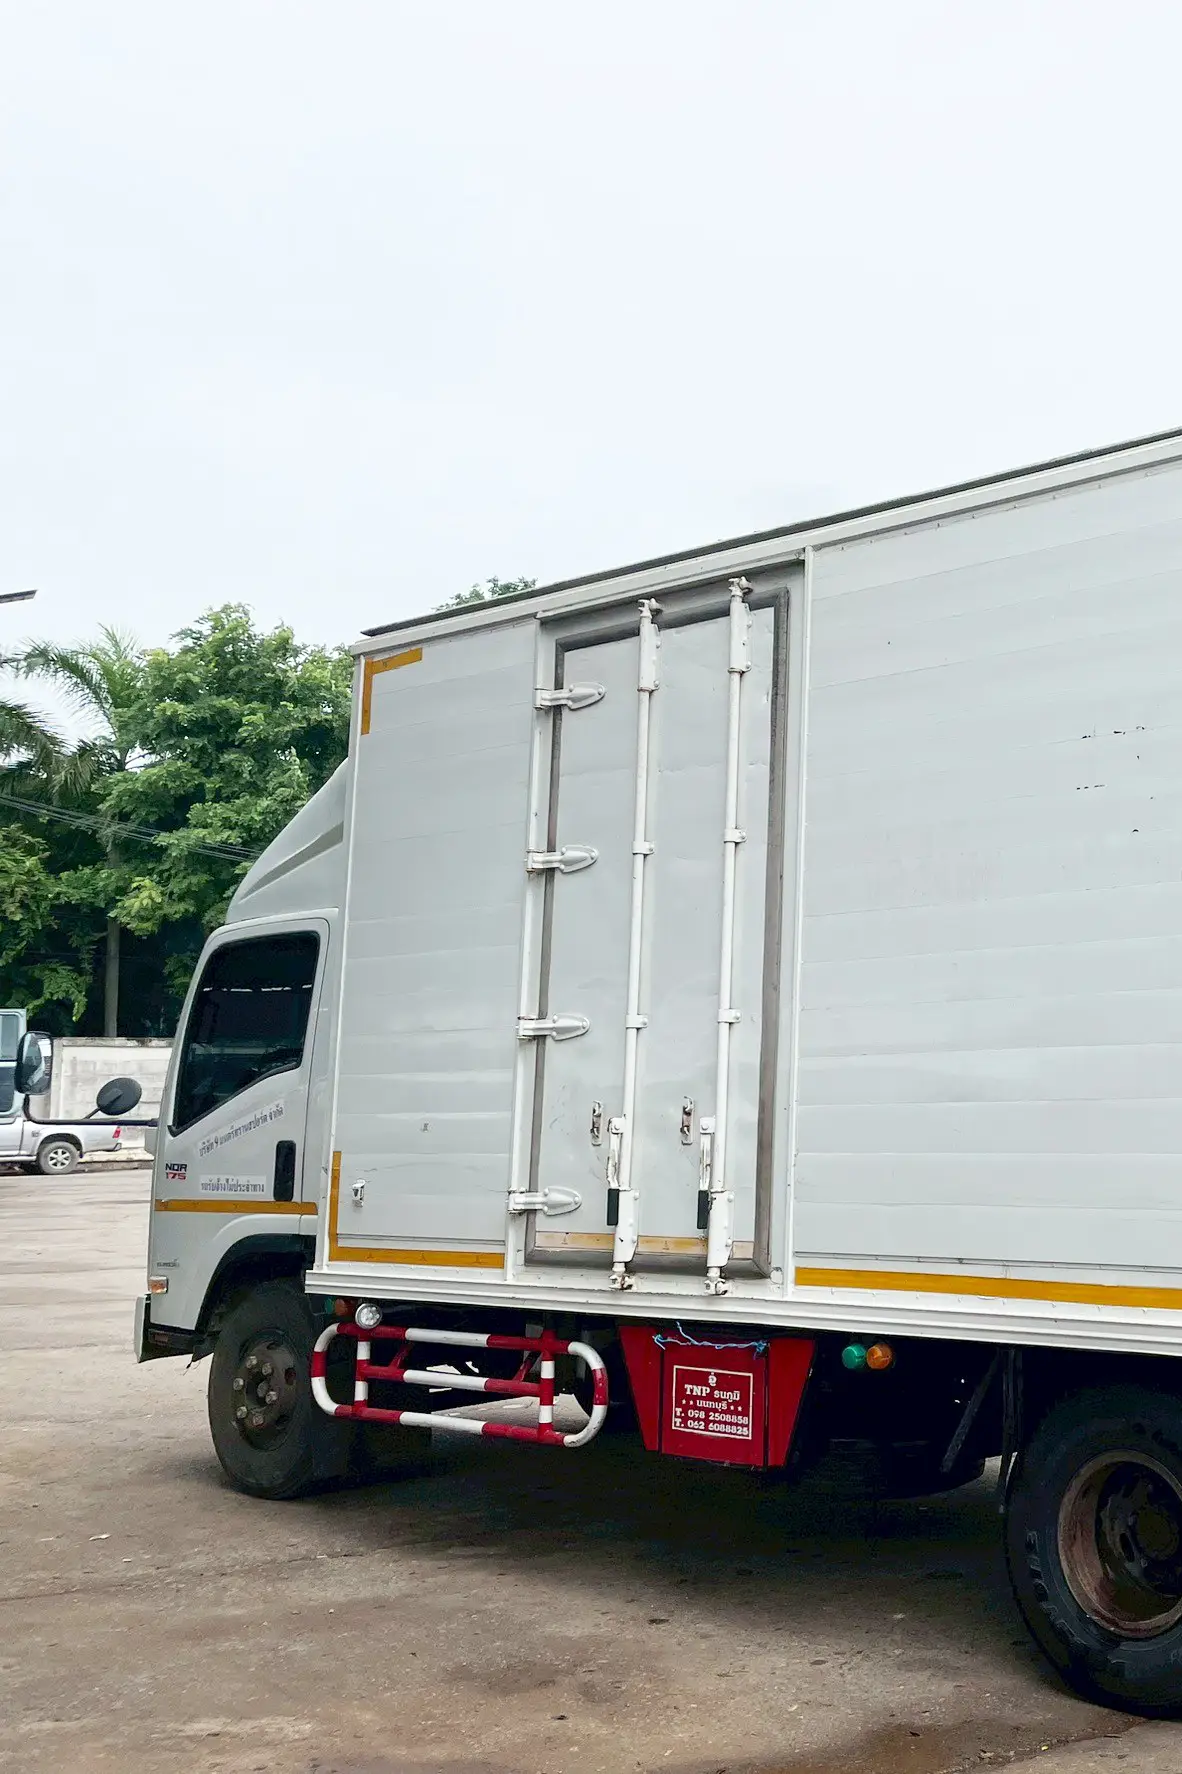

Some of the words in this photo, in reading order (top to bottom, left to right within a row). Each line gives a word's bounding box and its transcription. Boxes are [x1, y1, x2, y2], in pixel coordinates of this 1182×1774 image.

[165, 1163, 187, 1172] NQR
[165, 1172, 187, 1181] 175
[684, 1384, 710, 1397] TNP
[696, 1399, 728, 1411] นนทบุรี
[675, 1407, 685, 1417] T.
[688, 1409, 705, 1419] 098
[674, 1418, 684, 1427] T.
[687, 1419, 705, 1429] 062
